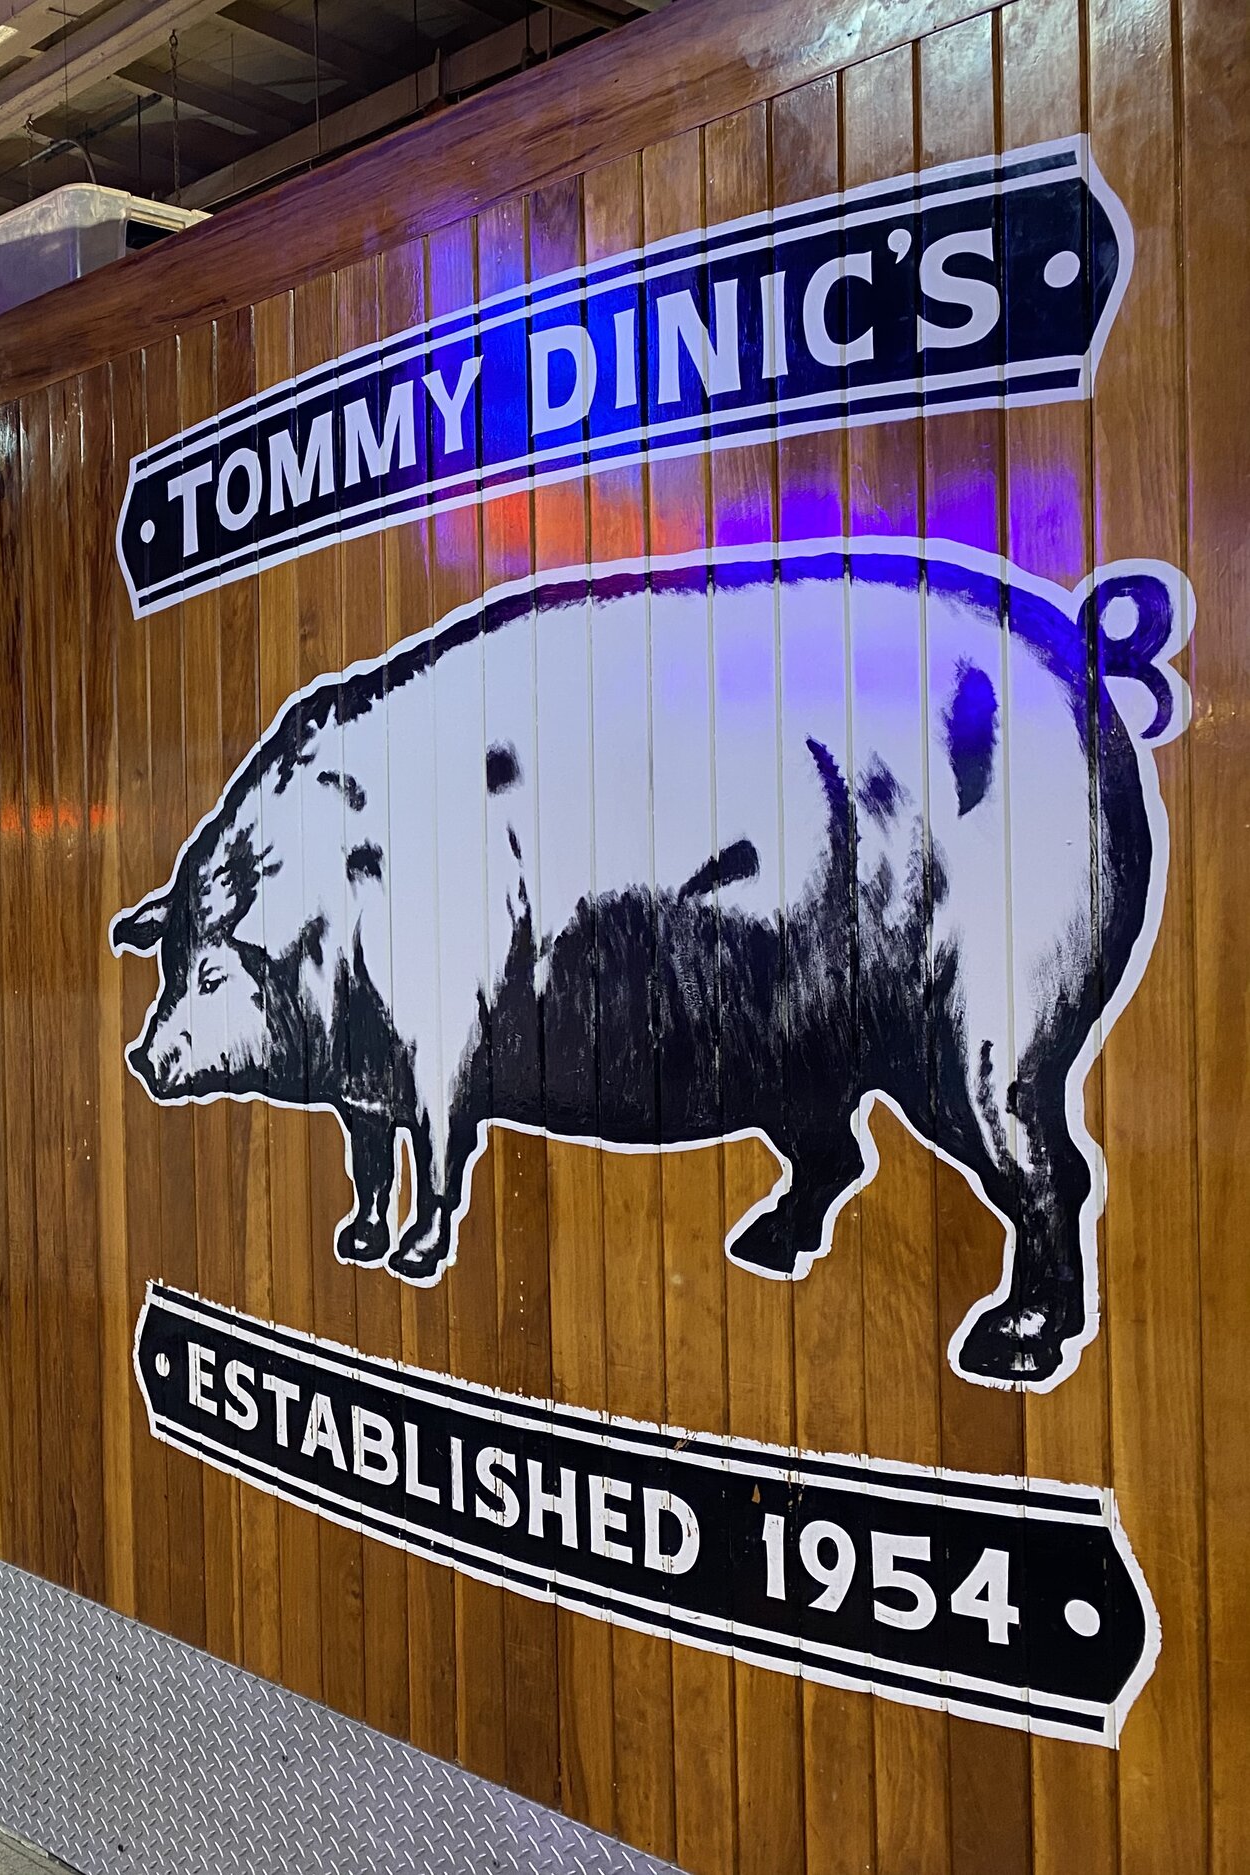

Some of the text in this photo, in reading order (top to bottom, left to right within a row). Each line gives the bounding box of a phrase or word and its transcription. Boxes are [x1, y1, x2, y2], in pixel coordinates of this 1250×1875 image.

[168, 228, 1001, 557] TOMMY DINIC'S
[187, 1341, 1020, 1645] ESTABLISHED 1954
